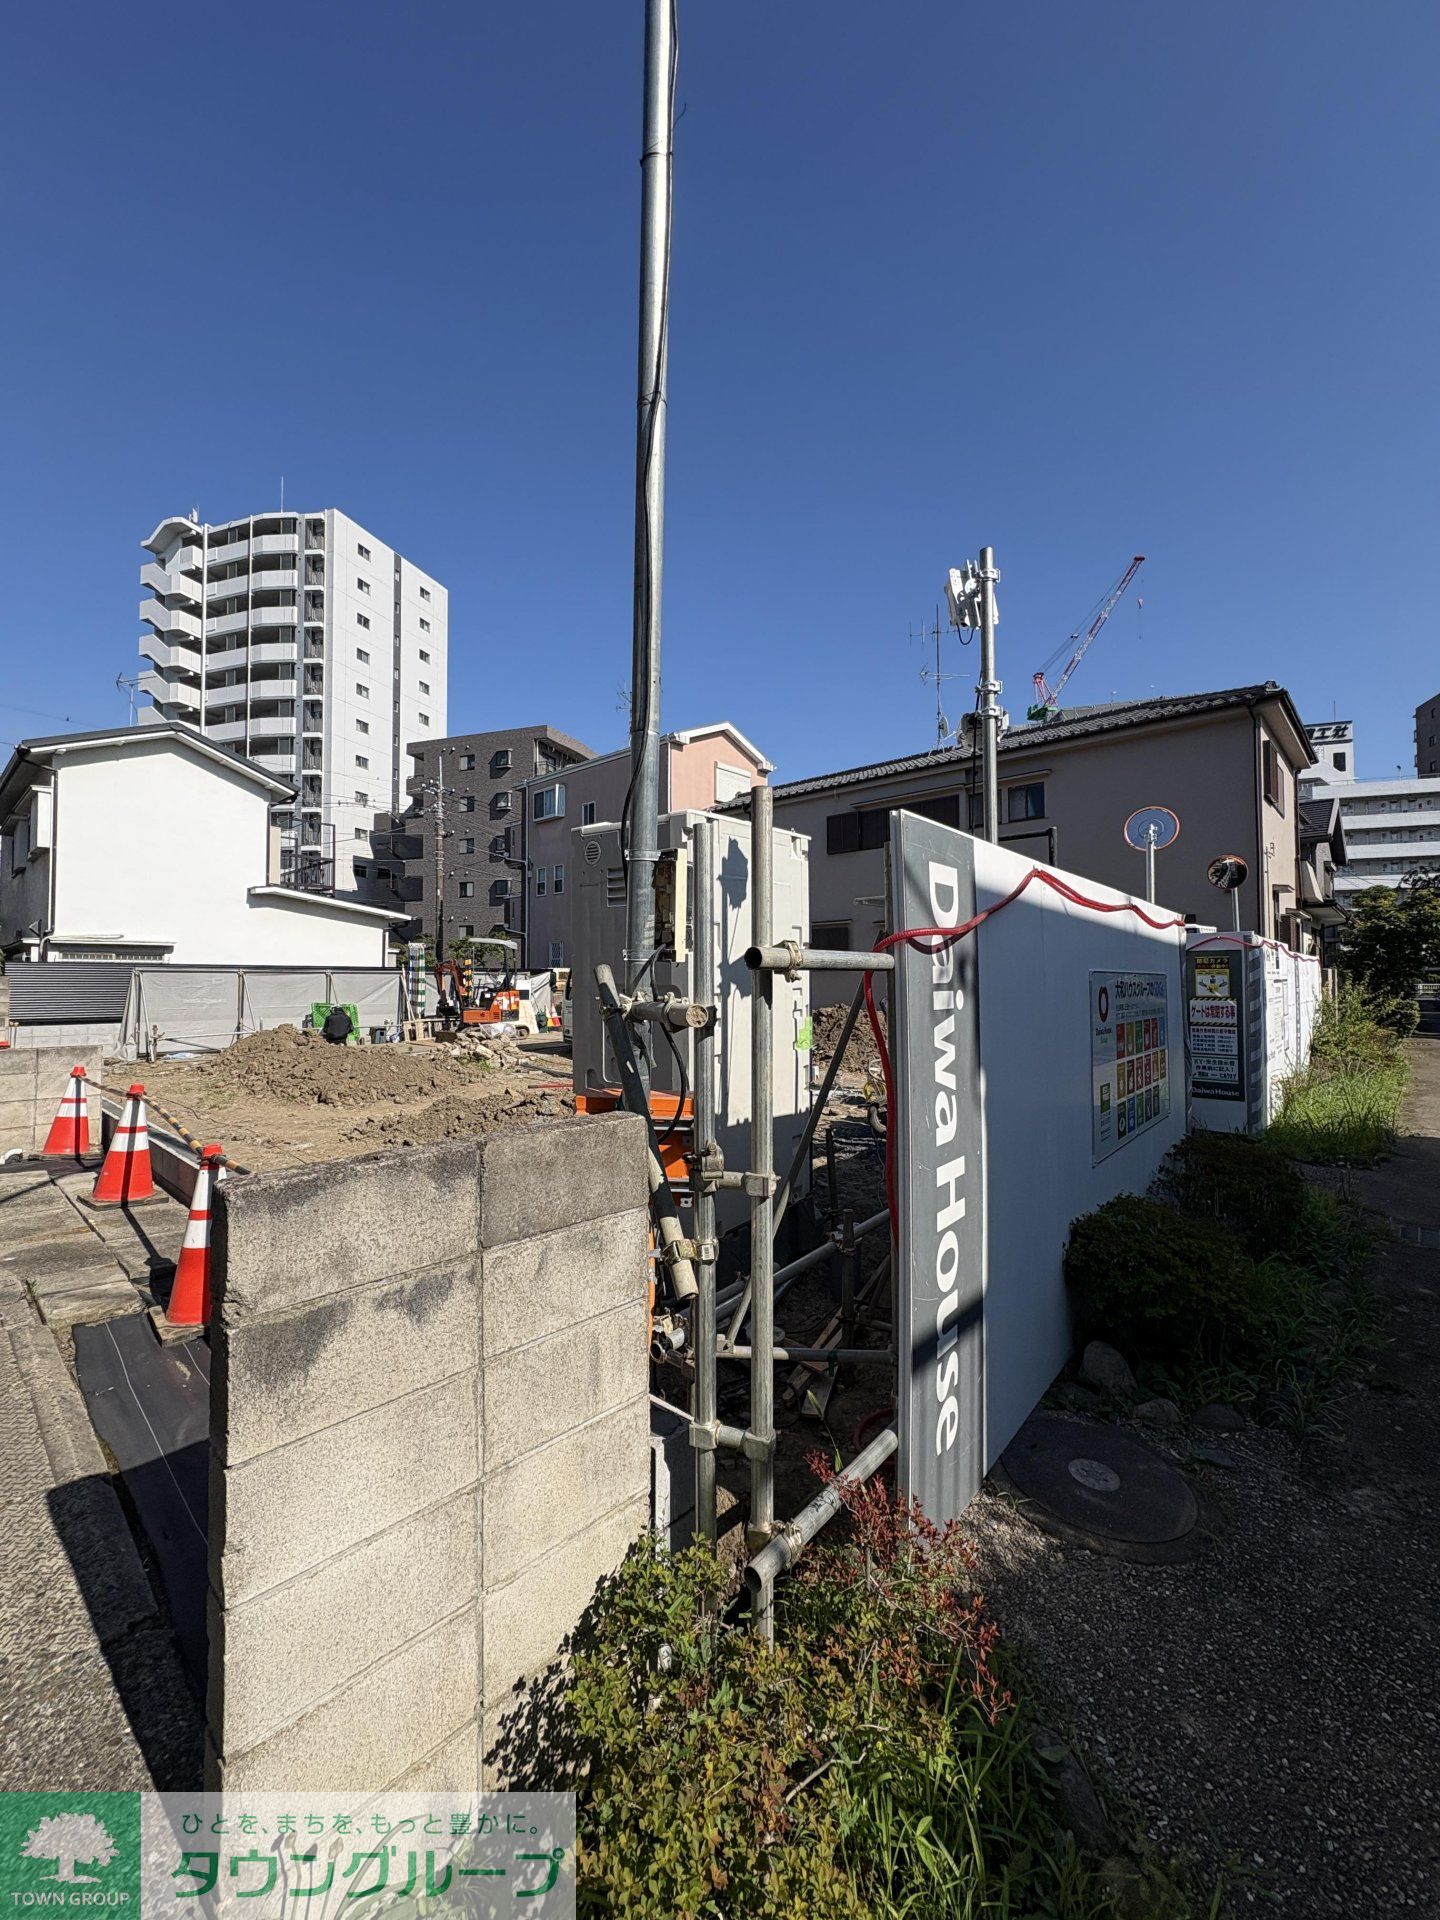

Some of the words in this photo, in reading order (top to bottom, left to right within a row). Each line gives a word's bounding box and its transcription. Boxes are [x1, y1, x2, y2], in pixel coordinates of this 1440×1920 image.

[928, 861, 964, 1147] Daiwa
[1192, 1086, 1214, 1095] Daiwa
[1216, 1088, 1240, 1097] House
[936, 1155, 966, 1456] House
